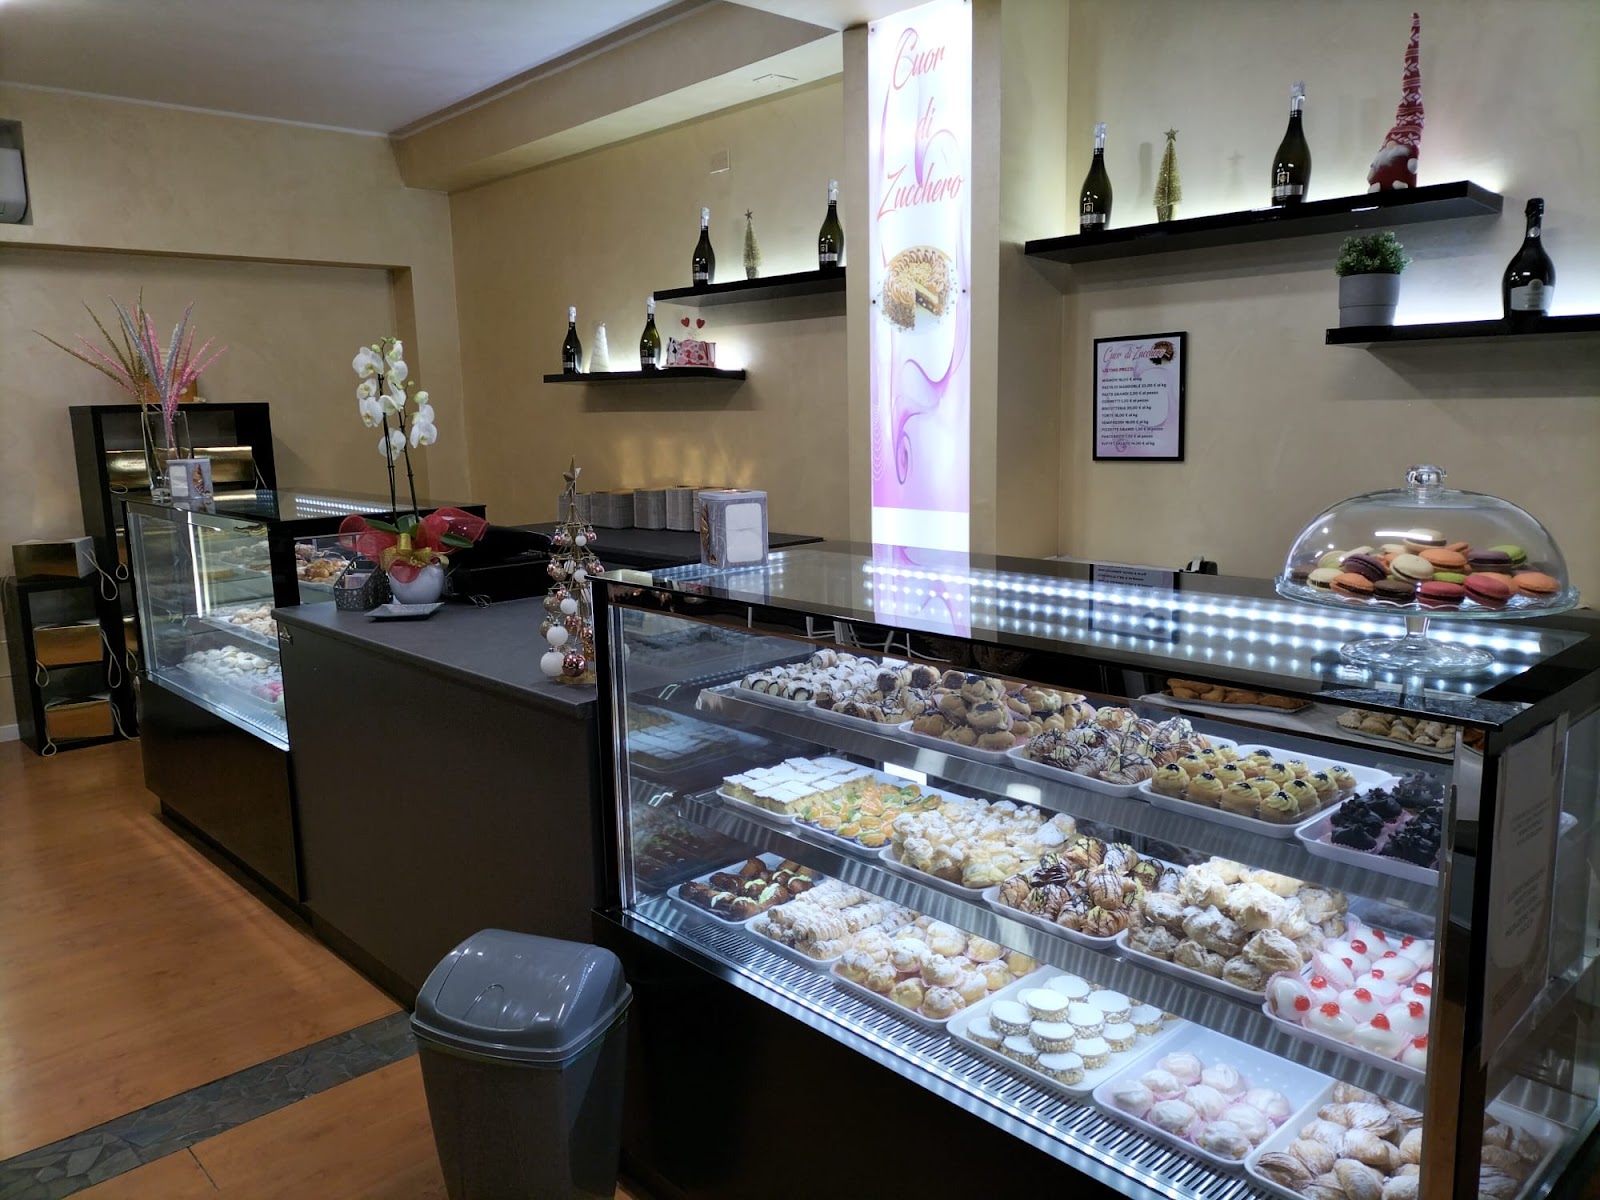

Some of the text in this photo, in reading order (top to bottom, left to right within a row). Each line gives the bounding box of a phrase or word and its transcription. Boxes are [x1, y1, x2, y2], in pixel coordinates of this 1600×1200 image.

[893, 27, 946, 90] Cuor
[915, 96, 936, 140] di
[876, 162, 964, 223] Zucchero
[1124, 346, 1132, 359] di
[1132, 345, 1164, 360] Zucchero
